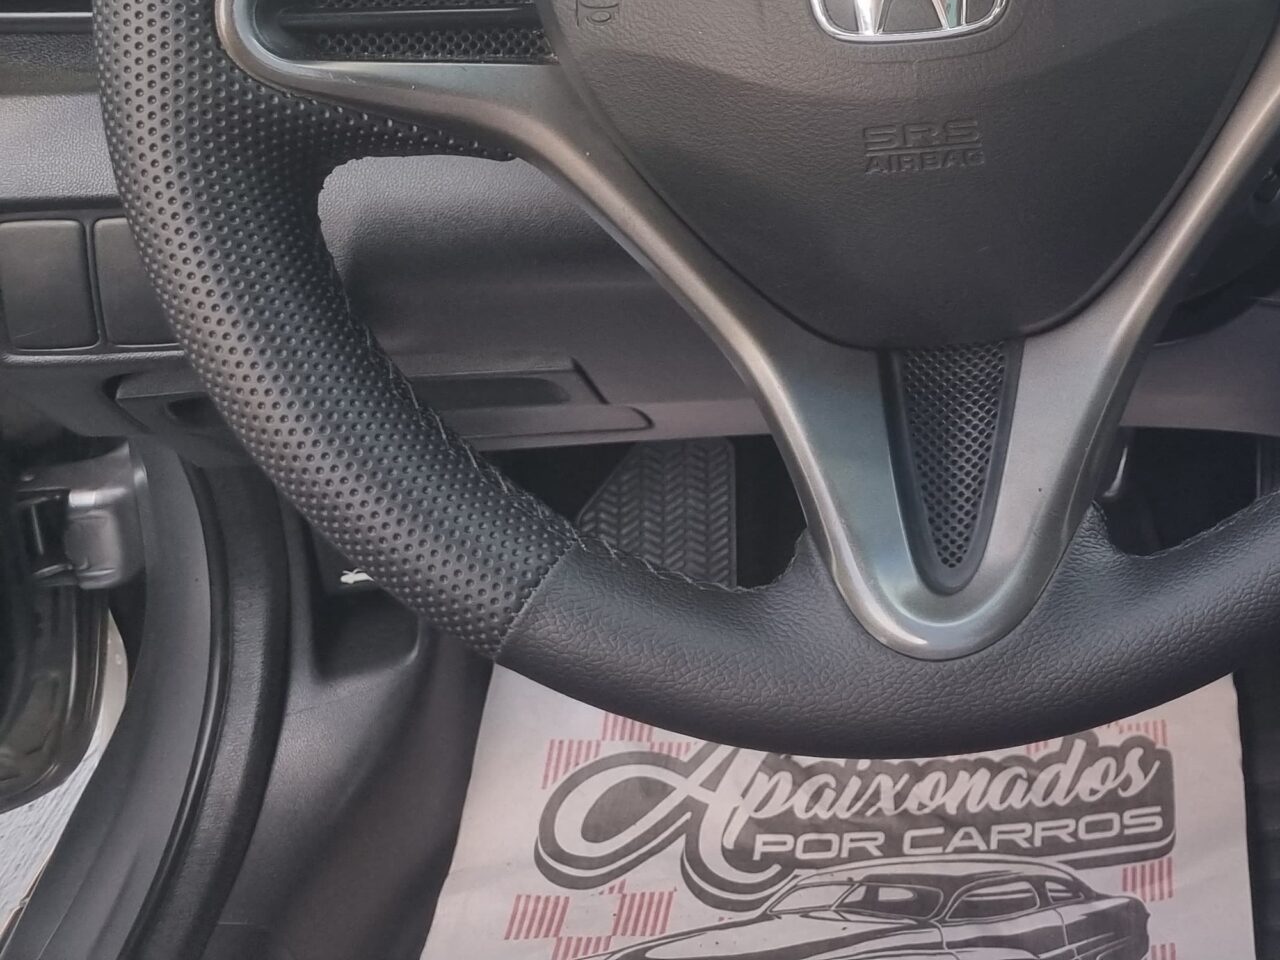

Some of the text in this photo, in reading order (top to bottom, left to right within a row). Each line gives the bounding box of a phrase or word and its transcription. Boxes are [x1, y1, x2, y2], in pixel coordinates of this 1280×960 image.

[554, 738, 1160, 884] Apaixonados
[753, 806, 1163, 861] POR CARROS
